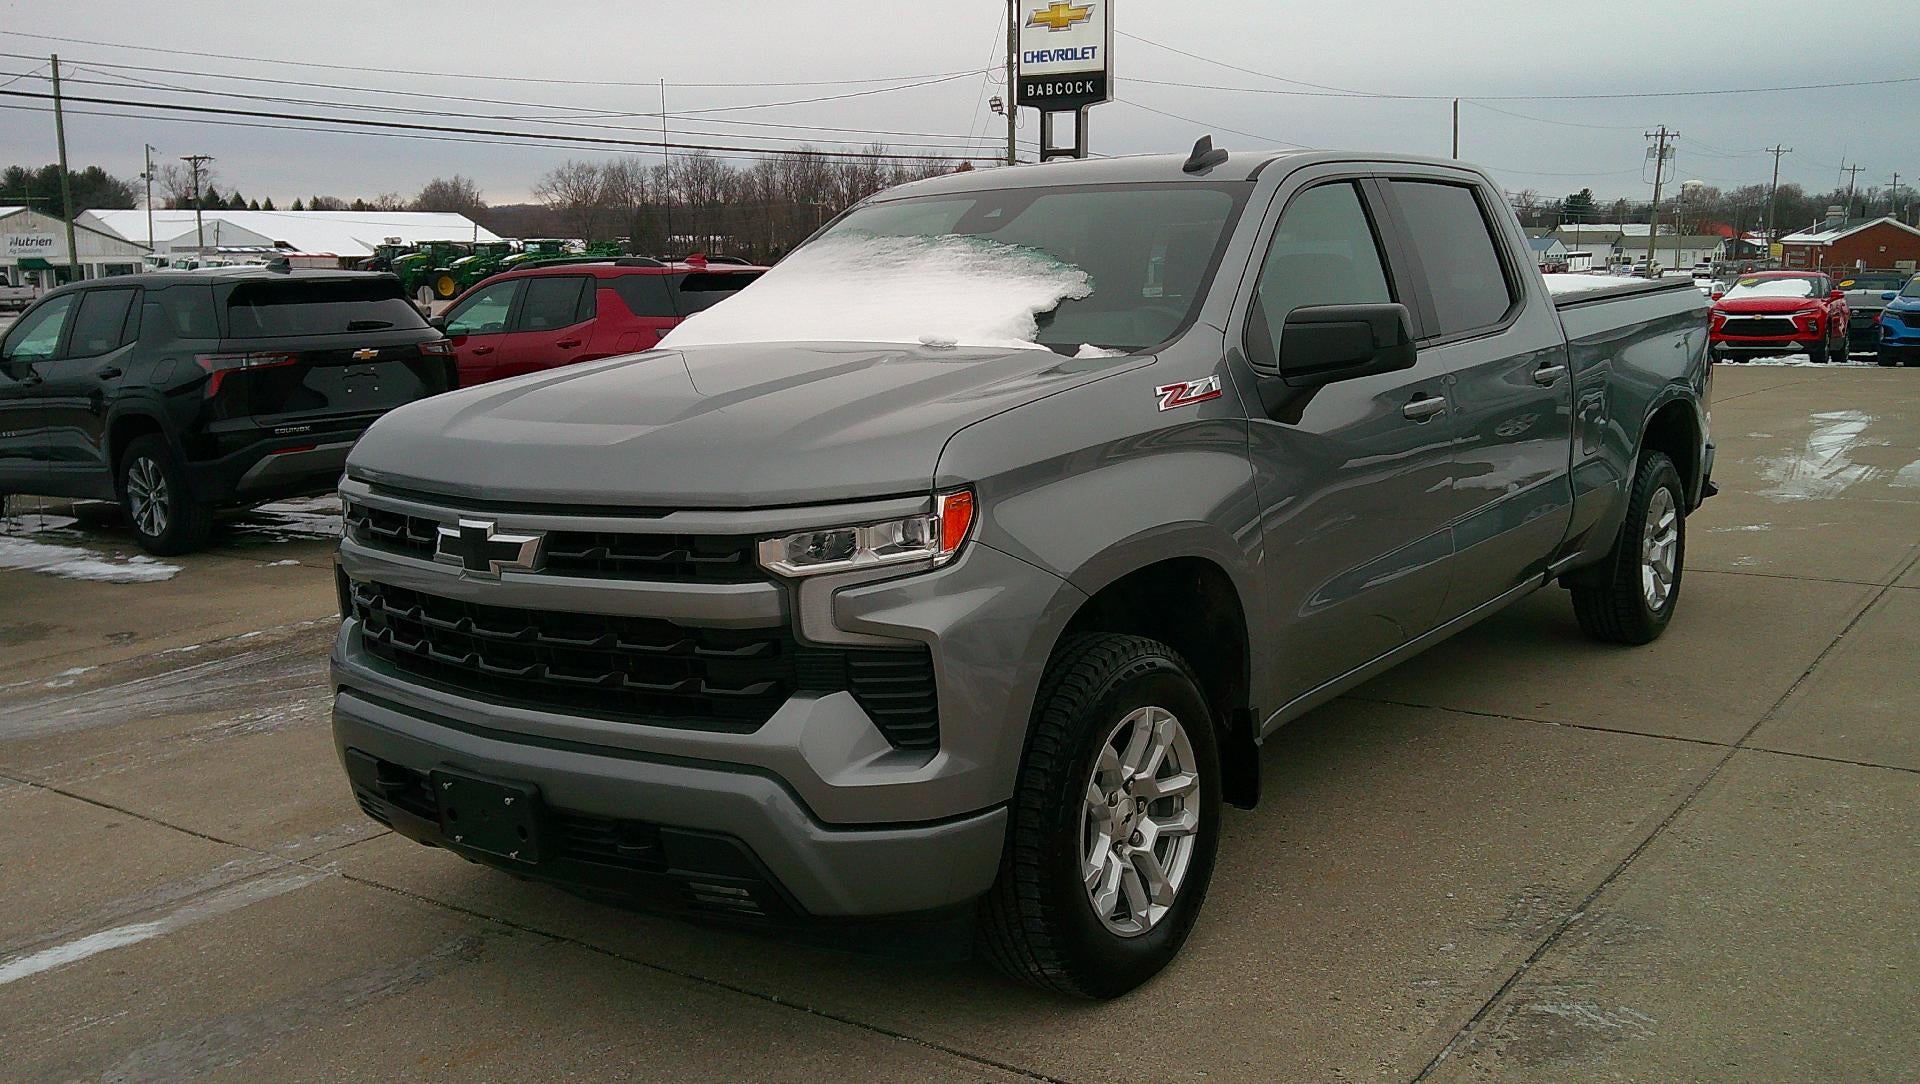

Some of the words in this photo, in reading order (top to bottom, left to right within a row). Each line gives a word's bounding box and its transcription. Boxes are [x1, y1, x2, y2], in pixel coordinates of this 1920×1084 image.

[1023, 46, 1097, 64] CHEVROLET
[1027, 80, 1094, 97] BABCOCK
[9, 236, 52, 247] Nutrien
[1155, 375, 1223, 412] Z71
[274, 425, 311, 434] EQUINOX
